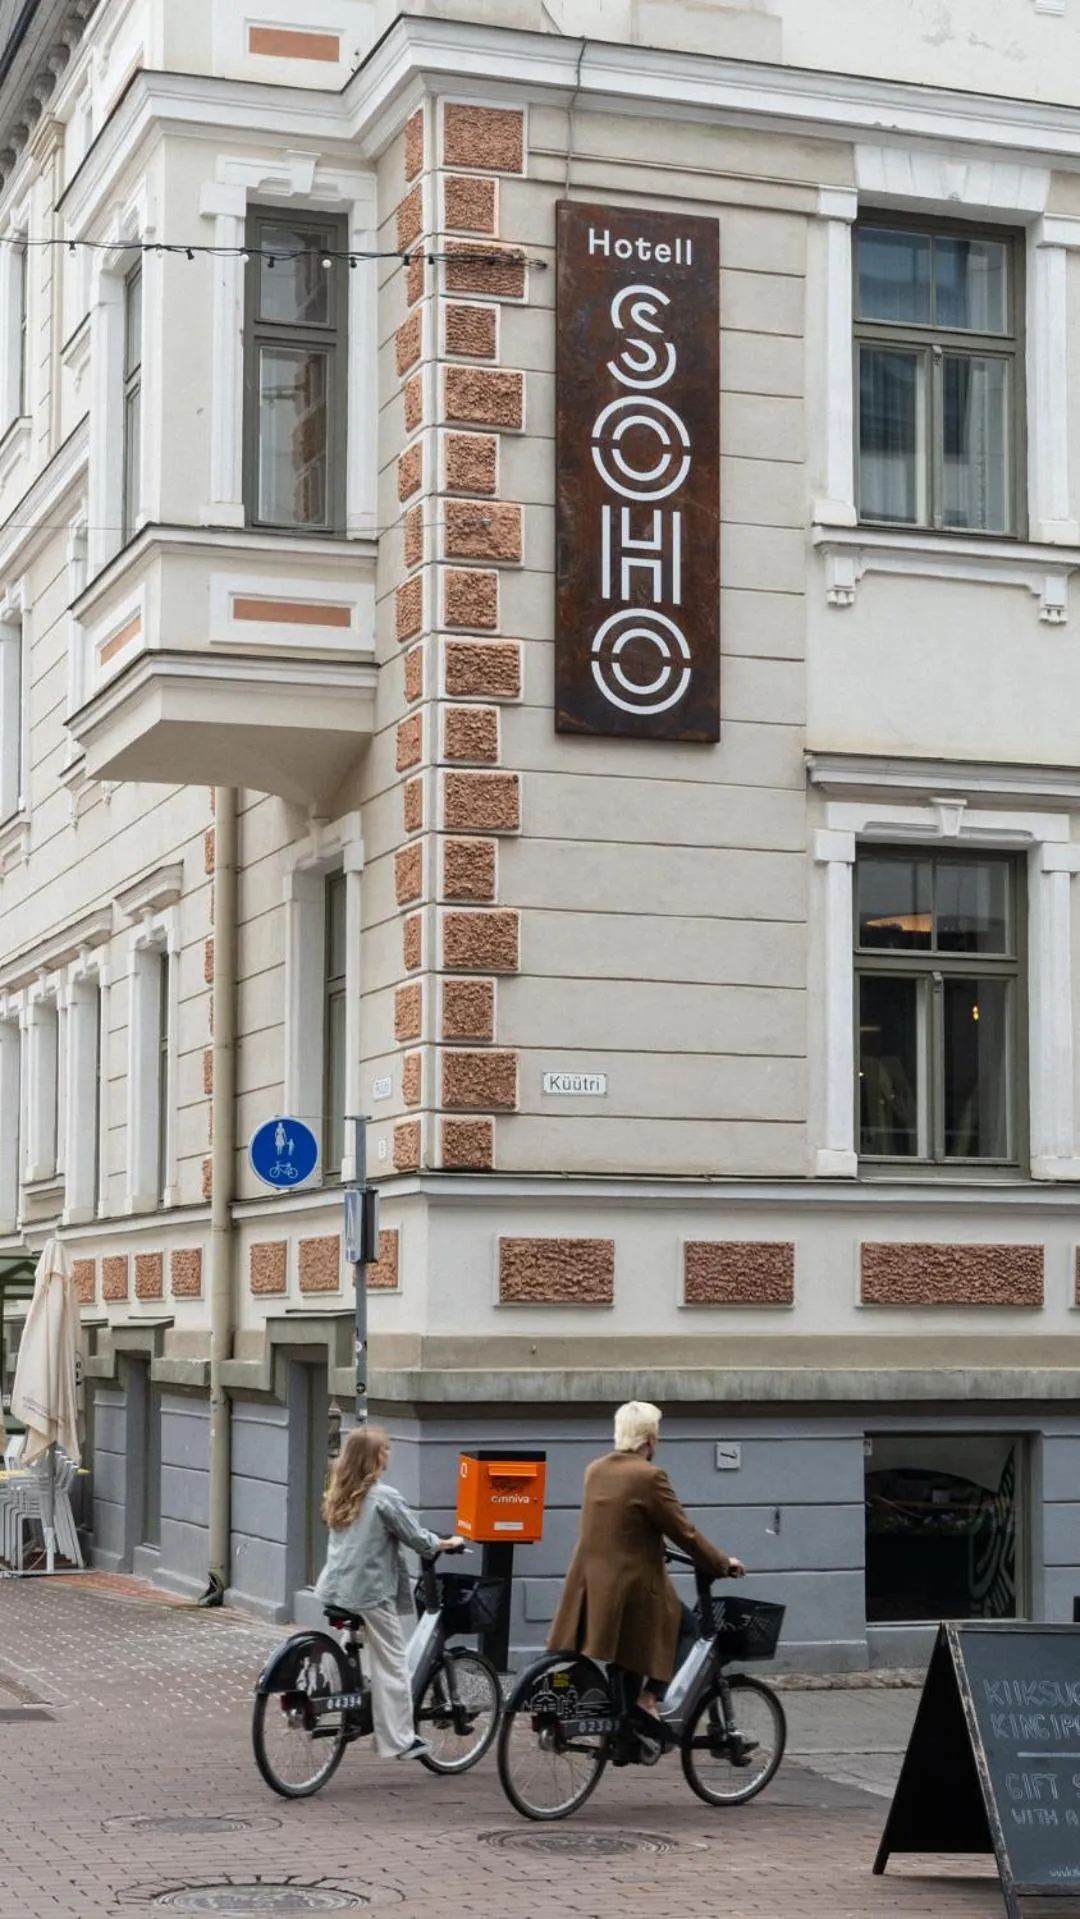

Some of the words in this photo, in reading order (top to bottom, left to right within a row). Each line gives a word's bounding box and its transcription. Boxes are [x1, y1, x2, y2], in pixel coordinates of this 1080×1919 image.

[588, 227, 692, 265] Hotell
[591, 284, 692, 715] SOHO
[550, 1075, 600, 1091] Küütri
[491, 1493, 530, 1504] omniva
[1005, 1772, 1059, 1801] GIFT
[1011, 1807, 1058, 1825] WITH
